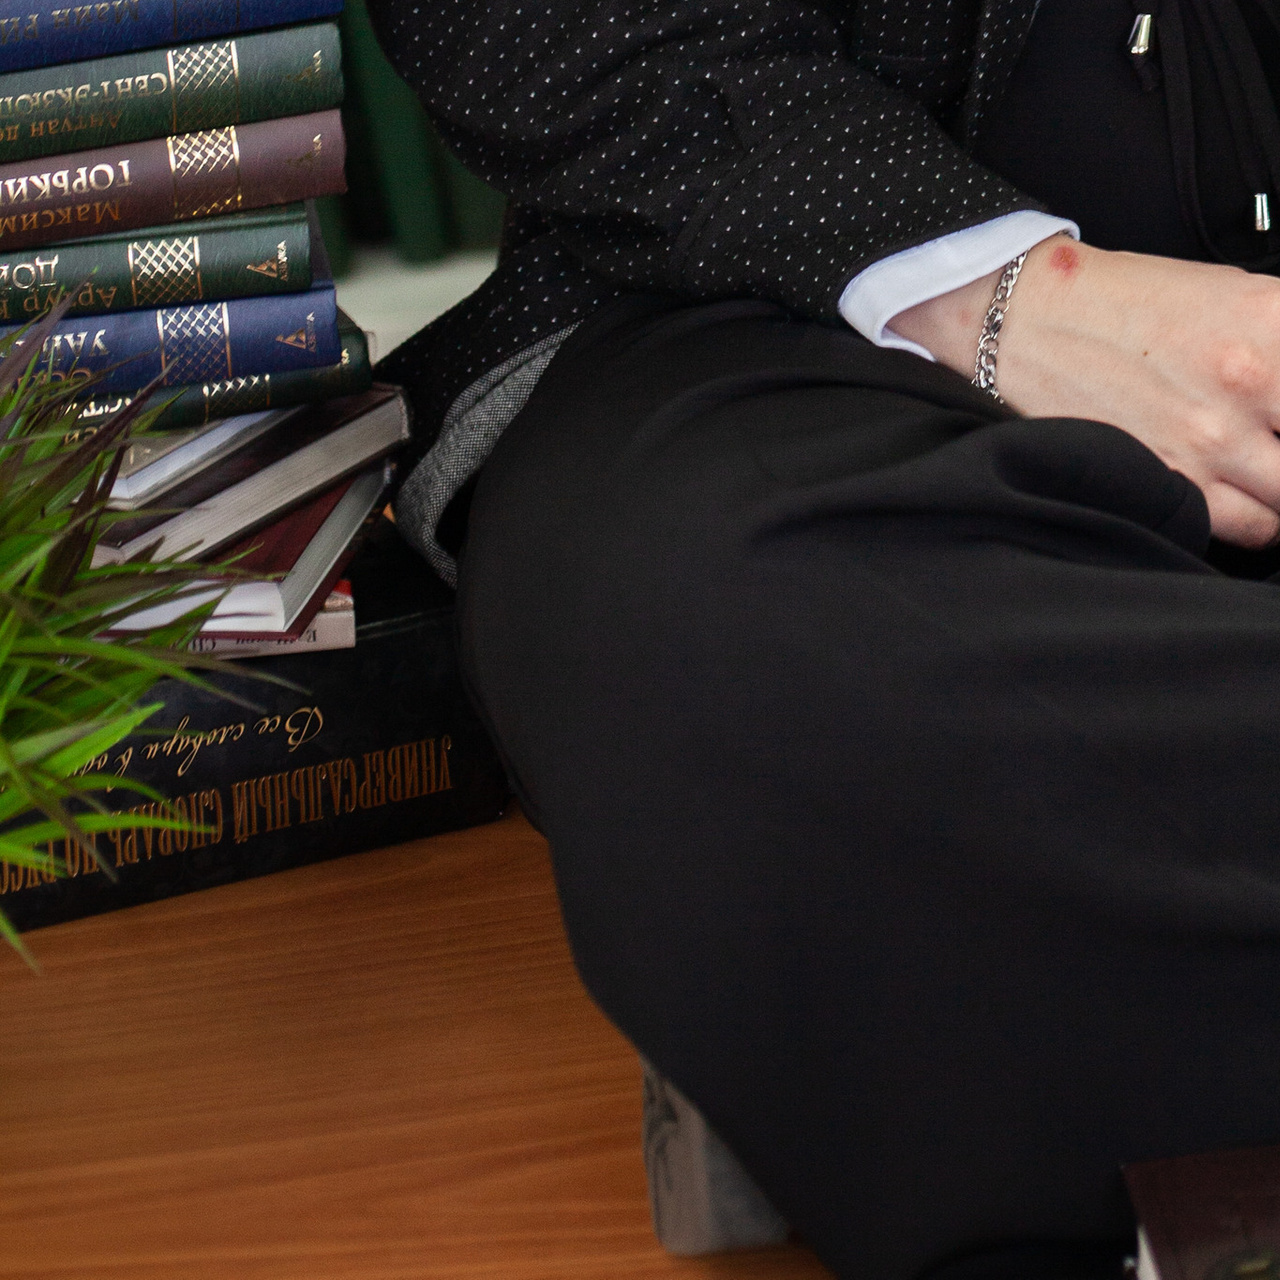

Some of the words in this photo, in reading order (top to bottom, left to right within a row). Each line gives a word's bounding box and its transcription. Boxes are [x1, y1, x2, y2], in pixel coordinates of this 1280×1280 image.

[142, 715, 246, 778] словари
[253, 705, 324, 753] Все
[231, 735, 454, 845] УНИВЕРСАЛЬНЫЙ
[109, 785, 224, 870] СЛОВАРЬ
